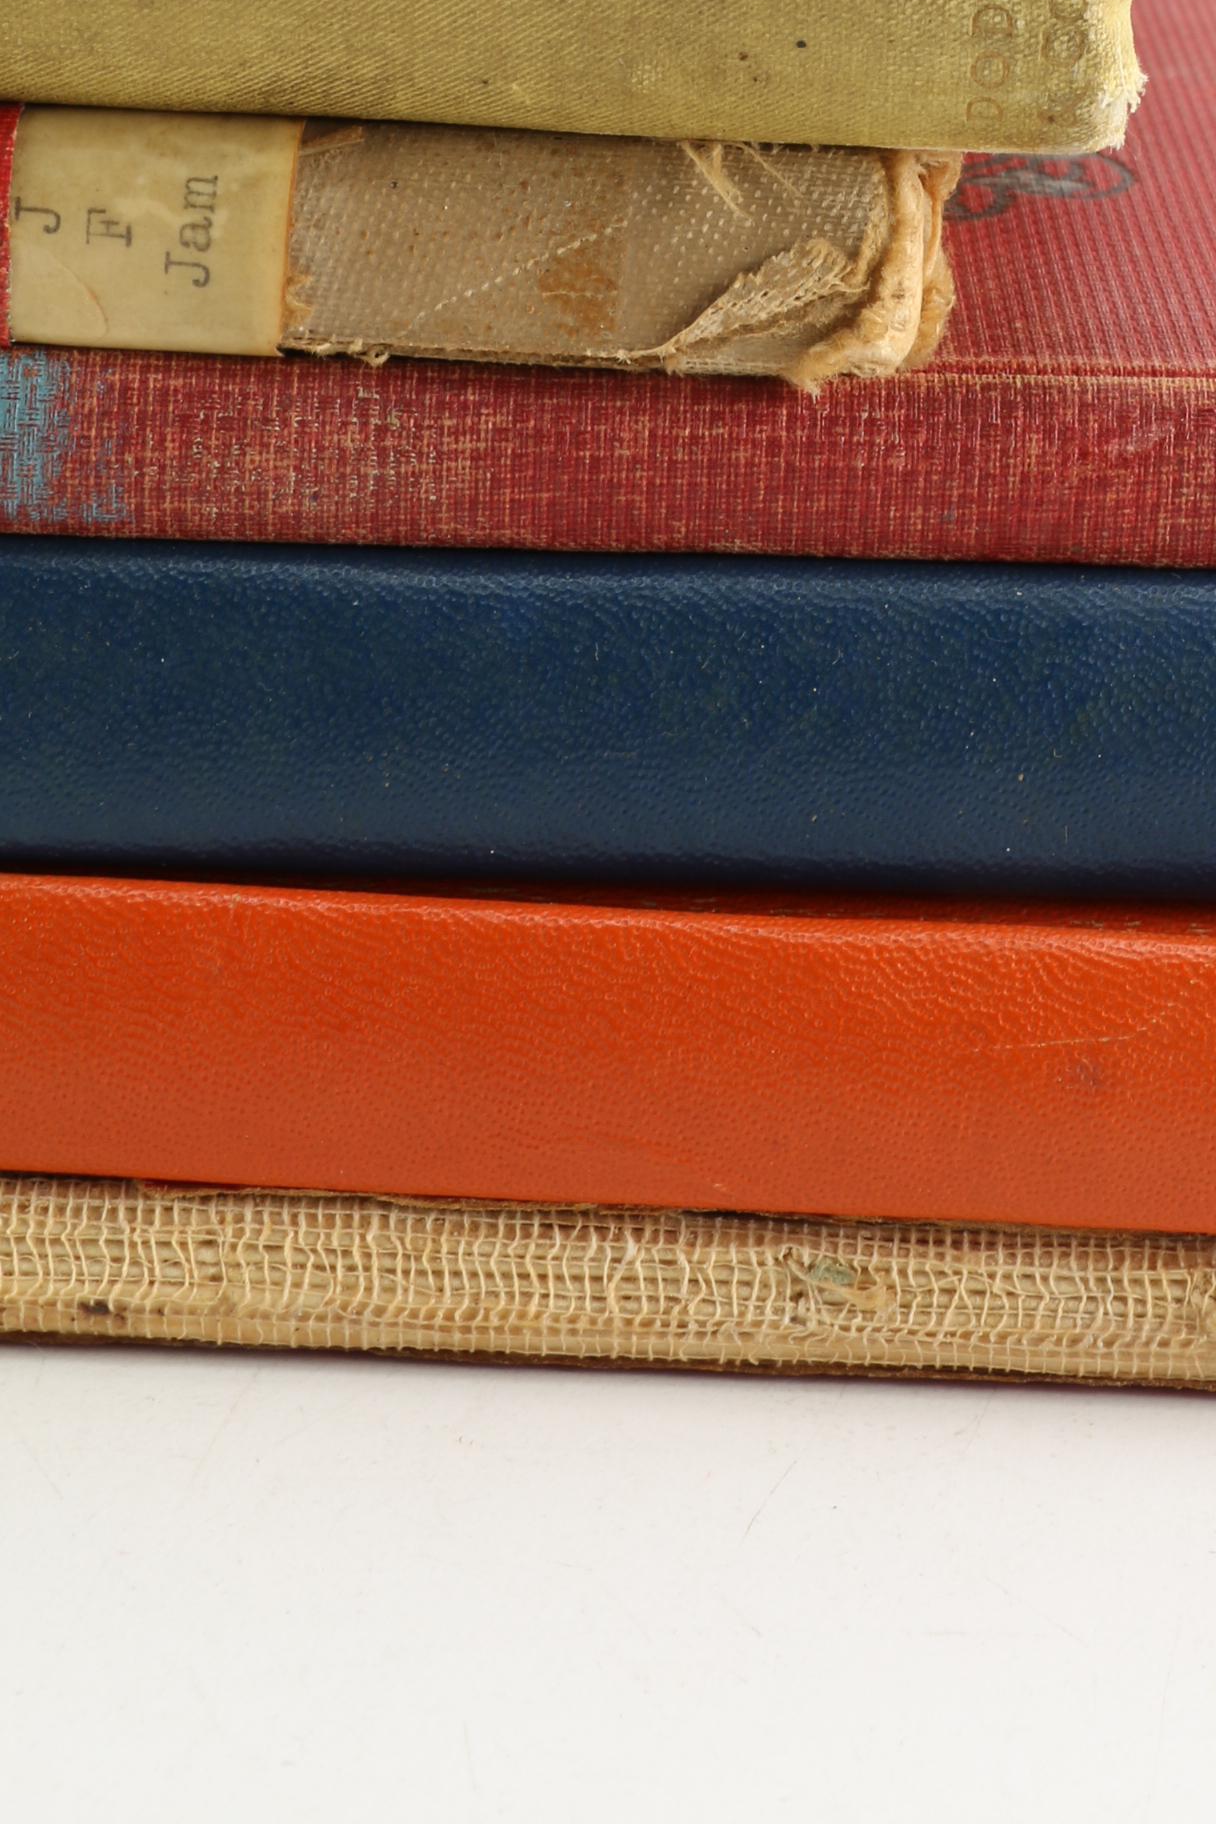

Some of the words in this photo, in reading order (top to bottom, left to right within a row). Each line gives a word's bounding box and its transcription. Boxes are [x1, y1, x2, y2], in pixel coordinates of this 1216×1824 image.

[14, 196, 61, 236] J
[85, 207, 133, 249] F
[163, 173, 219, 288] Jam
